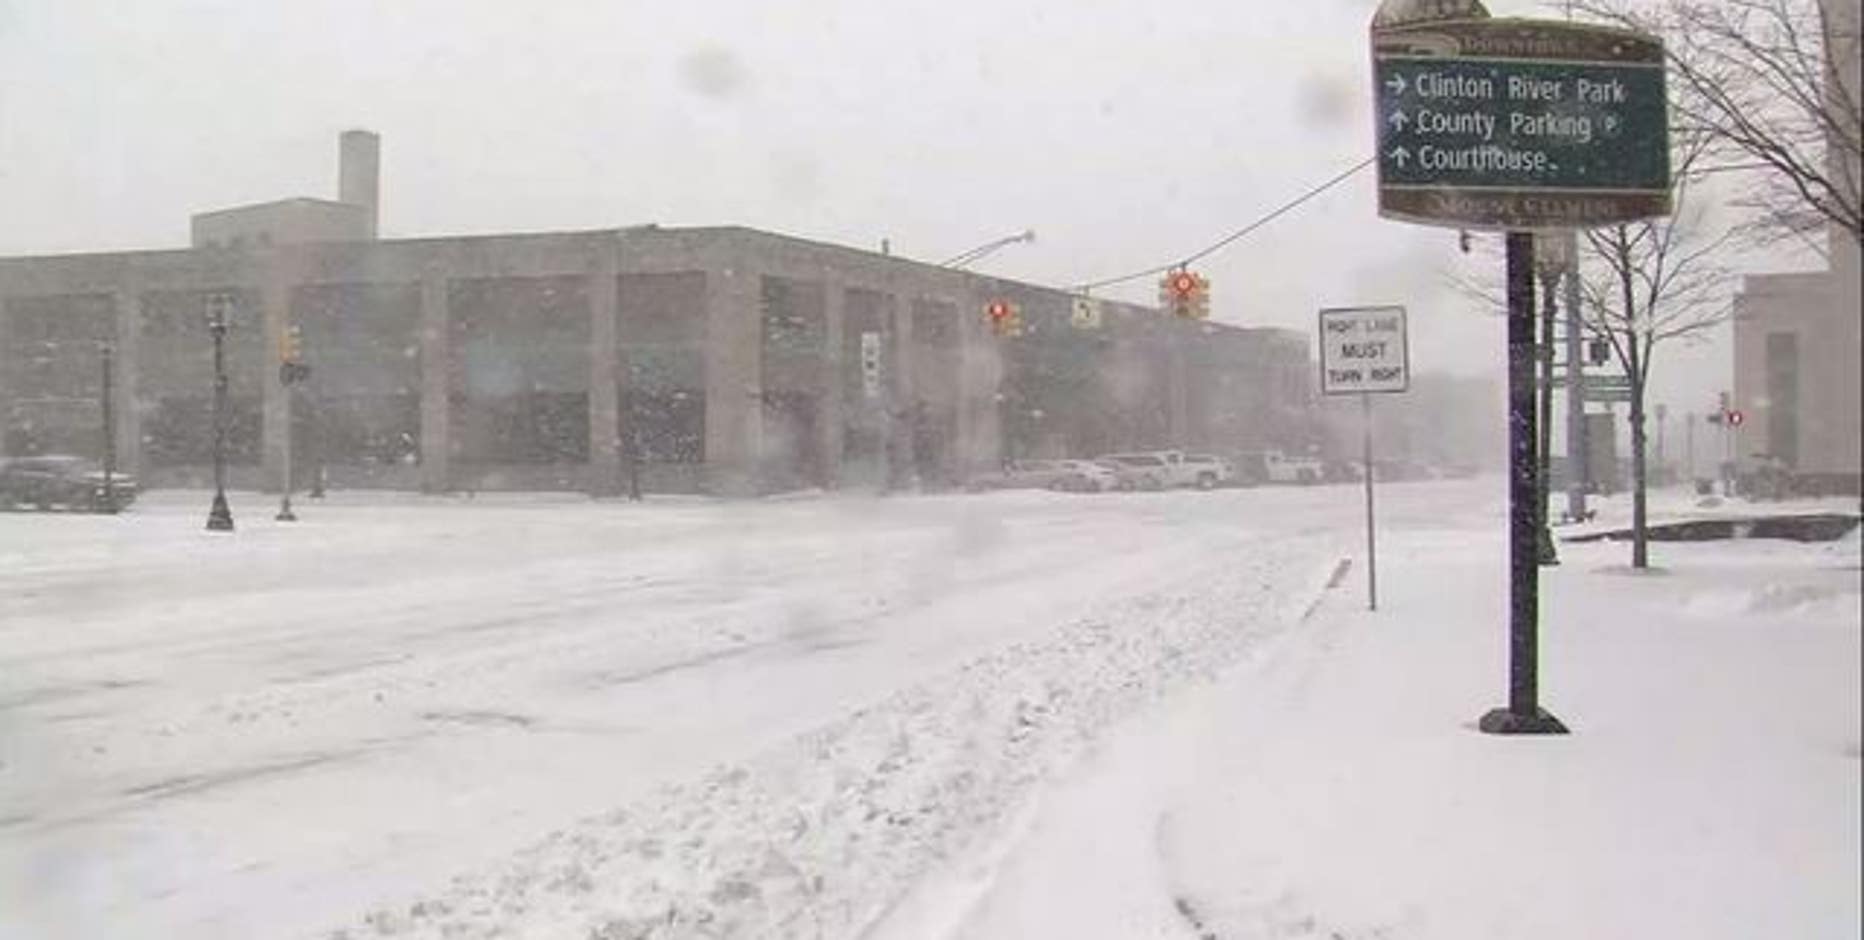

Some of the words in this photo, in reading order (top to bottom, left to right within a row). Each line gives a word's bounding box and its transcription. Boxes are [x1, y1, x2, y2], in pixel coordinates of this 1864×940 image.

[1416, 71, 1493, 100] Clinton
[1508, 75, 1563, 102] River
[1577, 78, 1626, 105] Park
[1417, 109, 1496, 140] County
[1510, 112, 1592, 143] Parking
[1419, 144, 1548, 172] Courthouse
[1342, 342, 1386, 358] MUST
[1327, 368, 1362, 383] TURN
